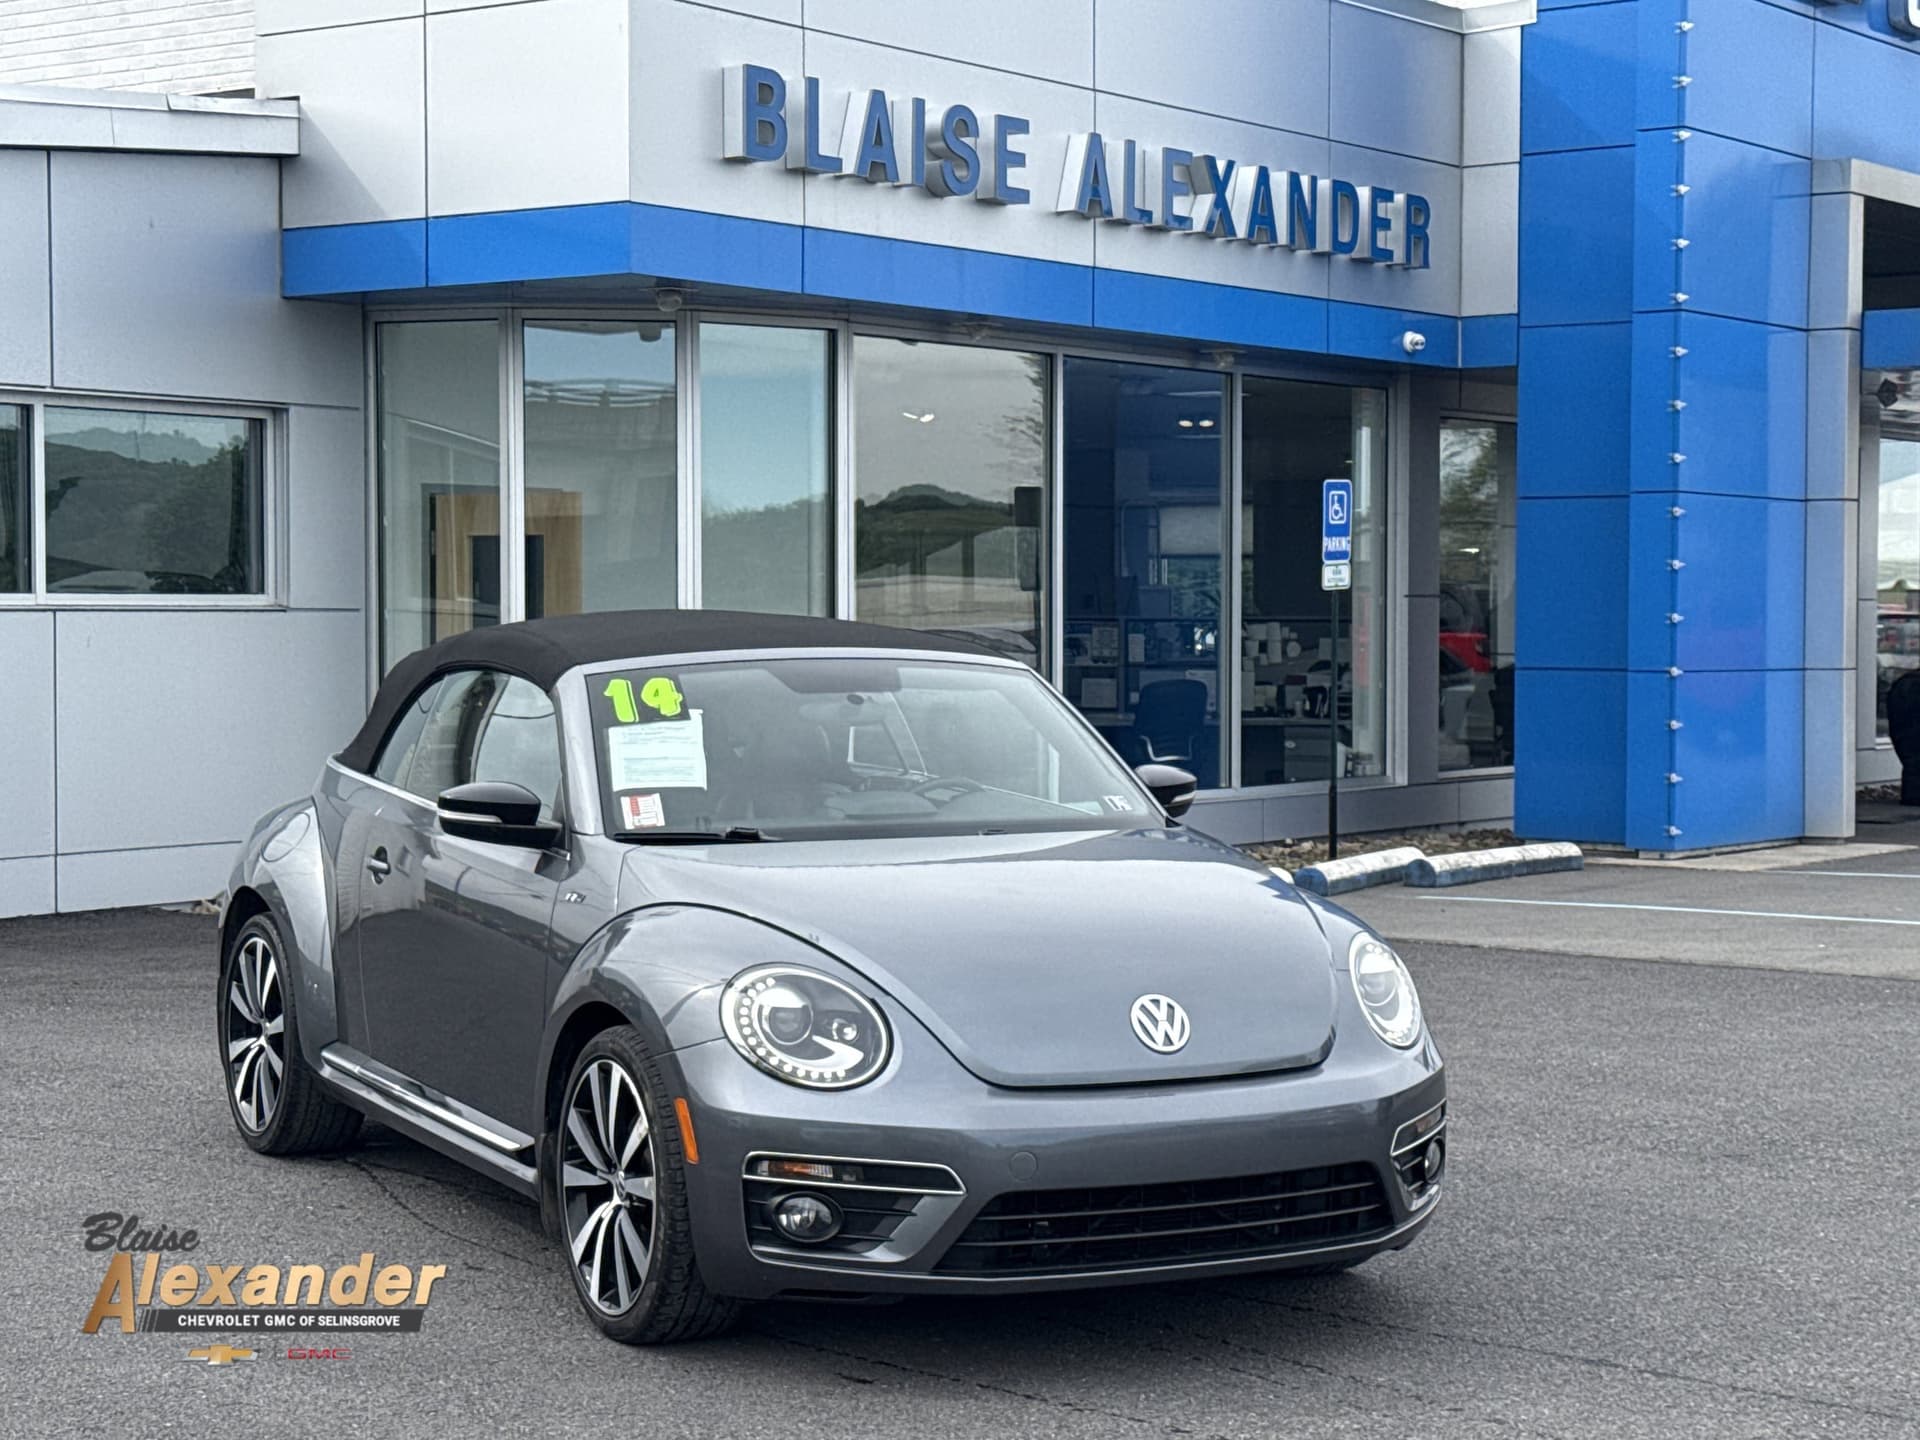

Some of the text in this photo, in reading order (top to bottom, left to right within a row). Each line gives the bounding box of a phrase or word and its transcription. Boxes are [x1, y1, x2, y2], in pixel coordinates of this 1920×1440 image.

[740, 63, 1431, 270] BLAISE ALEXANDER
[604, 677, 683, 723] 14
